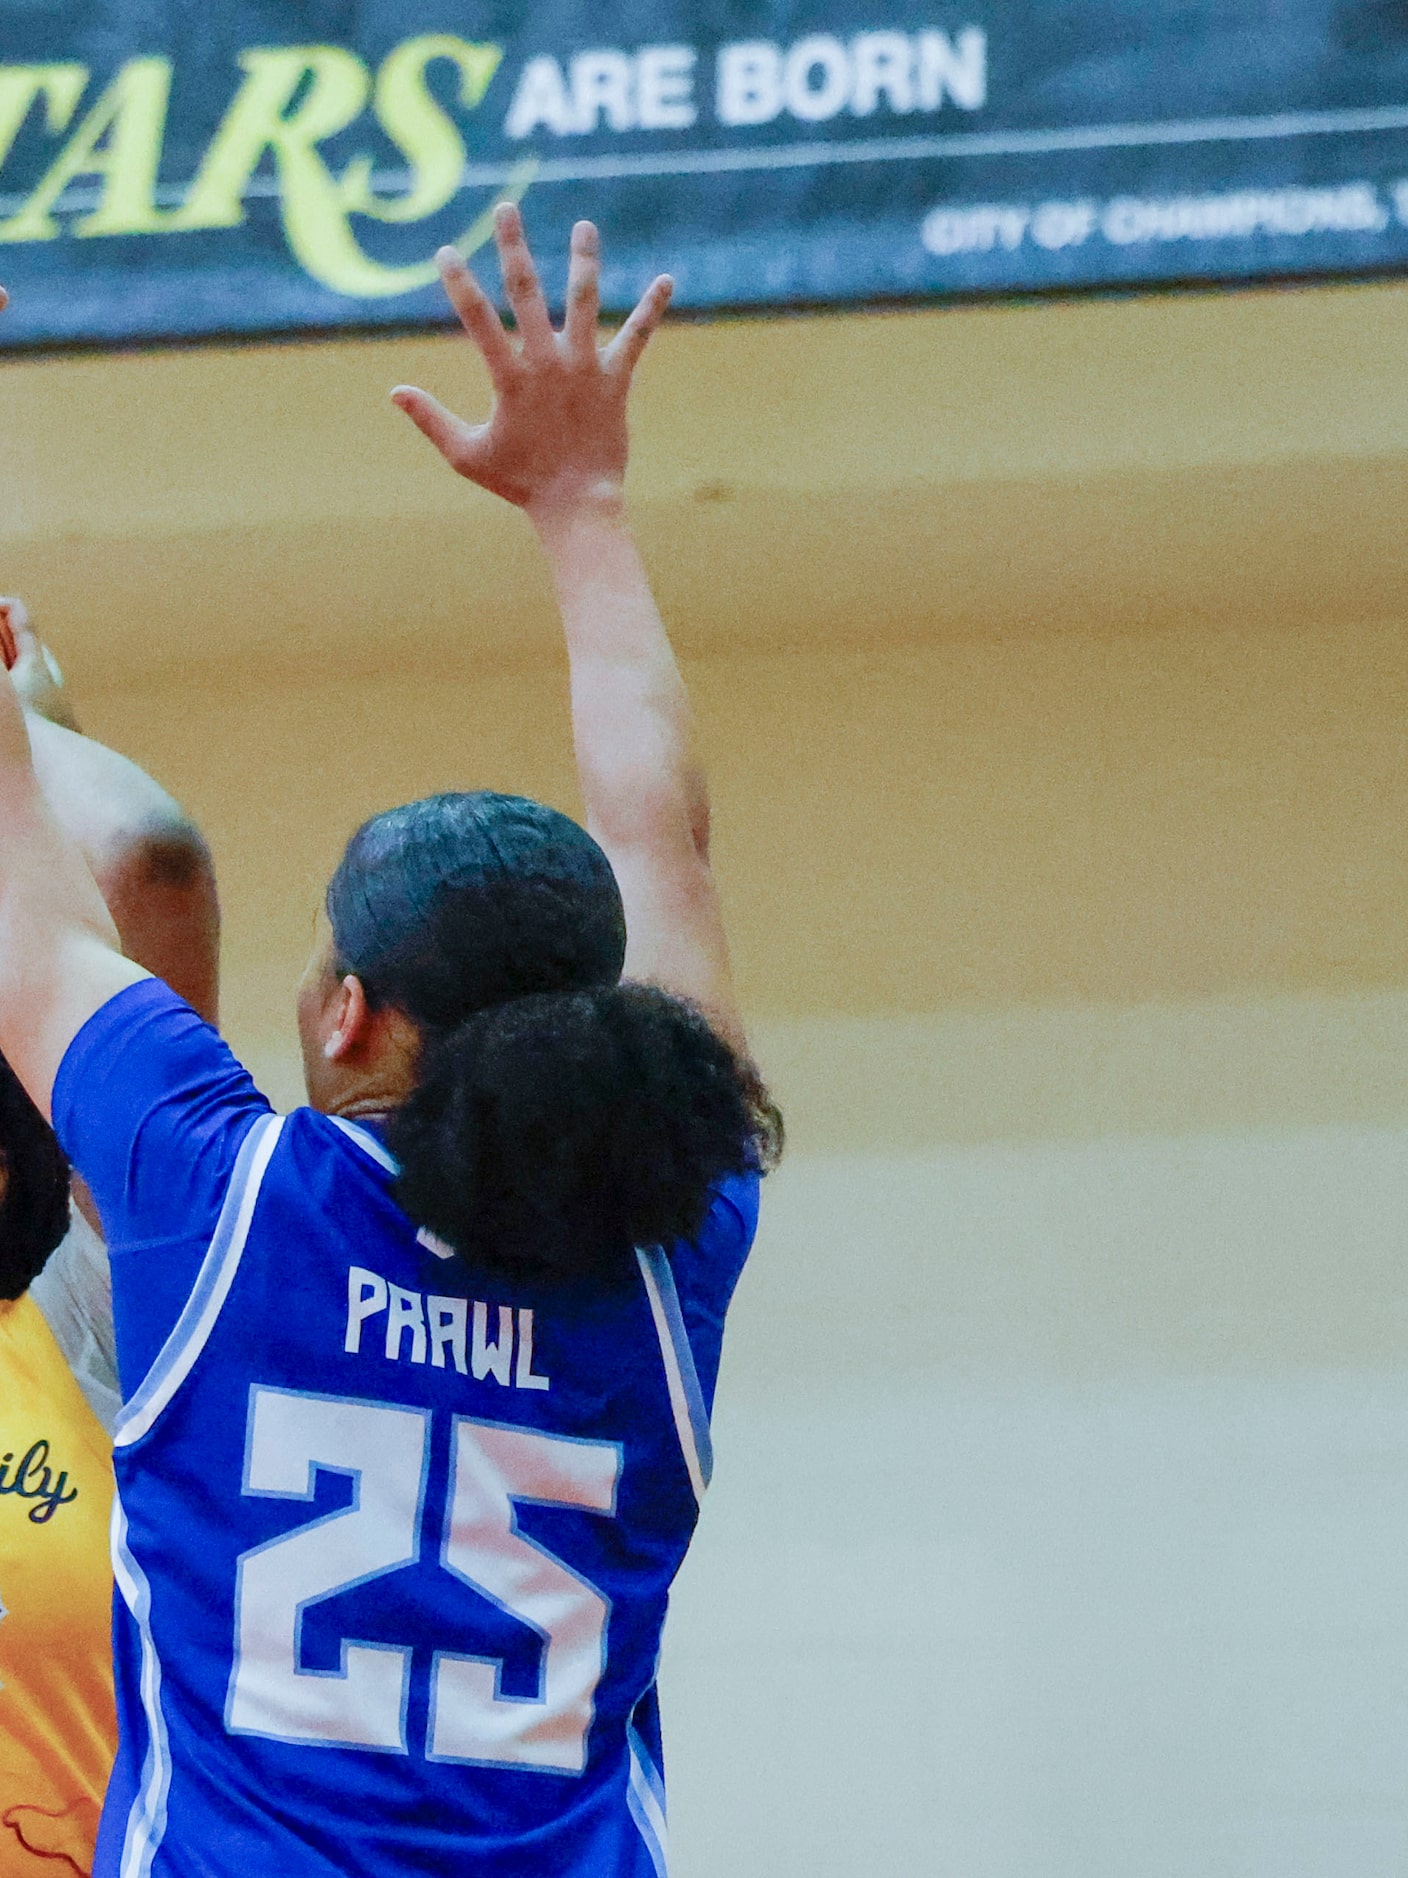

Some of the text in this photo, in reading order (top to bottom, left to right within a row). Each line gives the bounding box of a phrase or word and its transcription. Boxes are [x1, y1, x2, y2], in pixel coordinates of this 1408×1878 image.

[504, 46, 696, 140] ARE
[715, 27, 988, 128] BORN
[922, 205, 1030, 256] CITY
[1031, 200, 1094, 250] OF
[344, 1265, 550, 1391] PRAWL
[225, 1383, 624, 1777] 25
